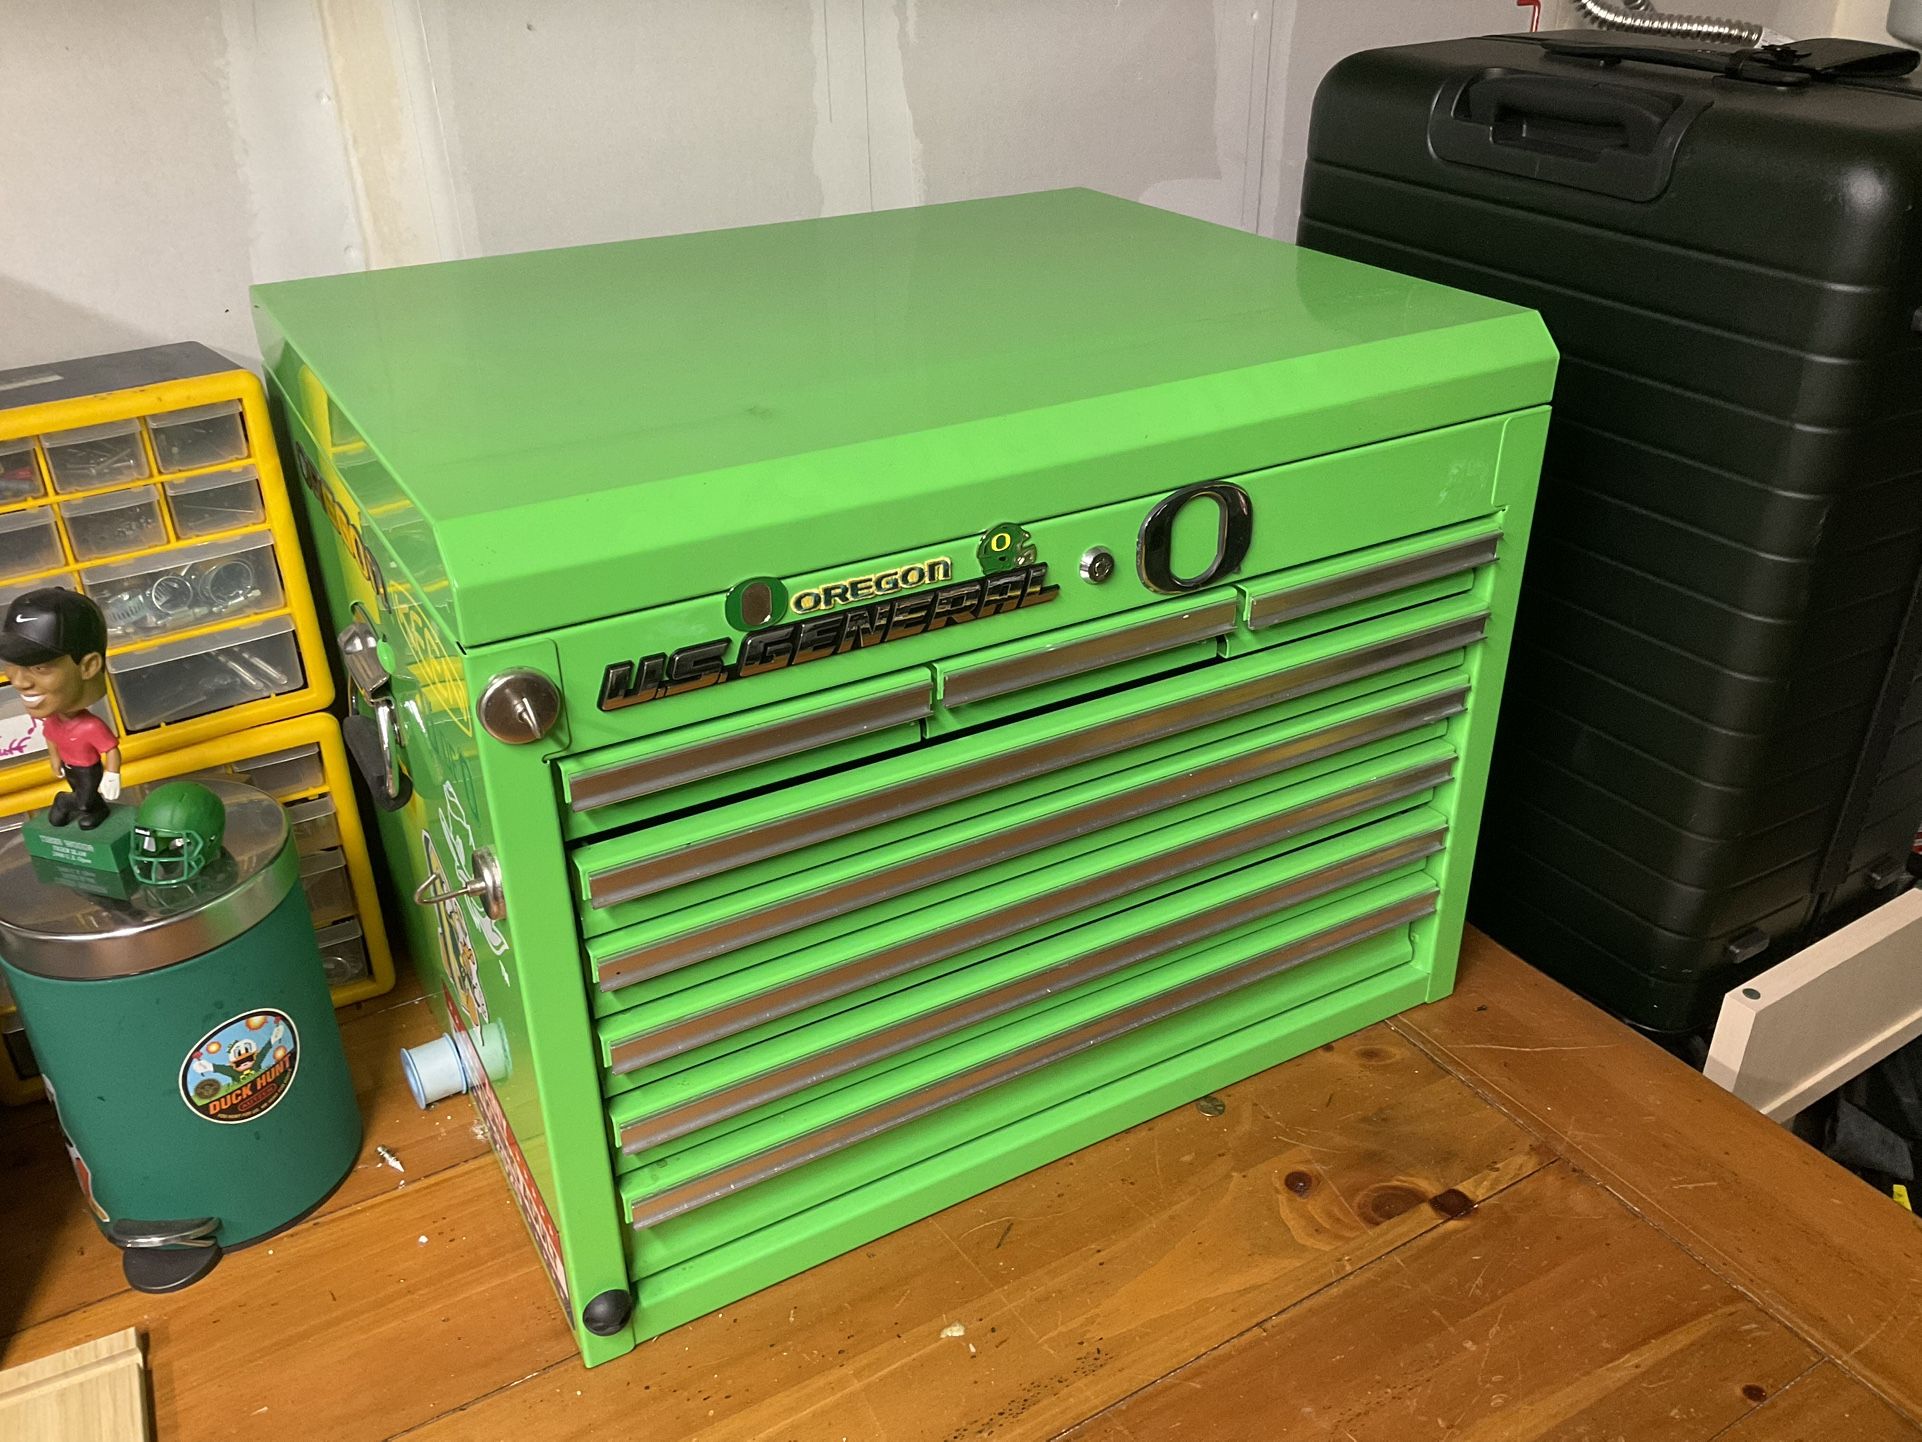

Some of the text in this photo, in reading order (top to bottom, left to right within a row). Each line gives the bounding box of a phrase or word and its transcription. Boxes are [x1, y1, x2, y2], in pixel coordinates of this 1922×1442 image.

[991, 532, 1011, 552] O
[1136, 480, 1253, 595] O
[790, 556, 953, 615] OREGON
[209, 1084, 253, 1115] DUCK
[256, 1053, 291, 1090] HUNT
